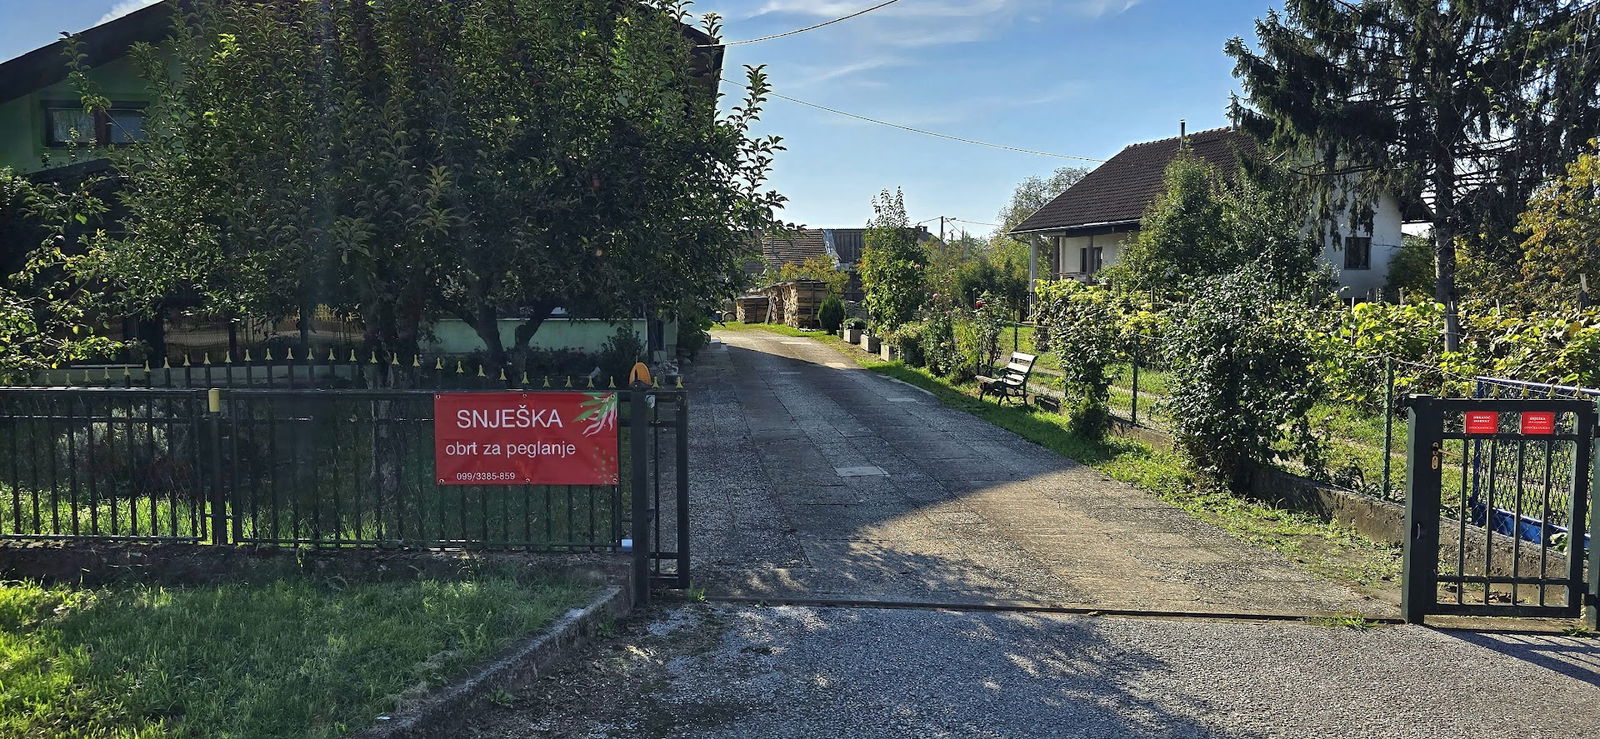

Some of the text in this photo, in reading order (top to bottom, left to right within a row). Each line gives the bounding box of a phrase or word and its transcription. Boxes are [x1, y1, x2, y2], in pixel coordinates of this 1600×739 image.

[456, 404, 563, 428] SNJEŠKA
[445, 441, 576, 458] obrt za peglanje
[456, 472, 516, 481] 099/3385-859
